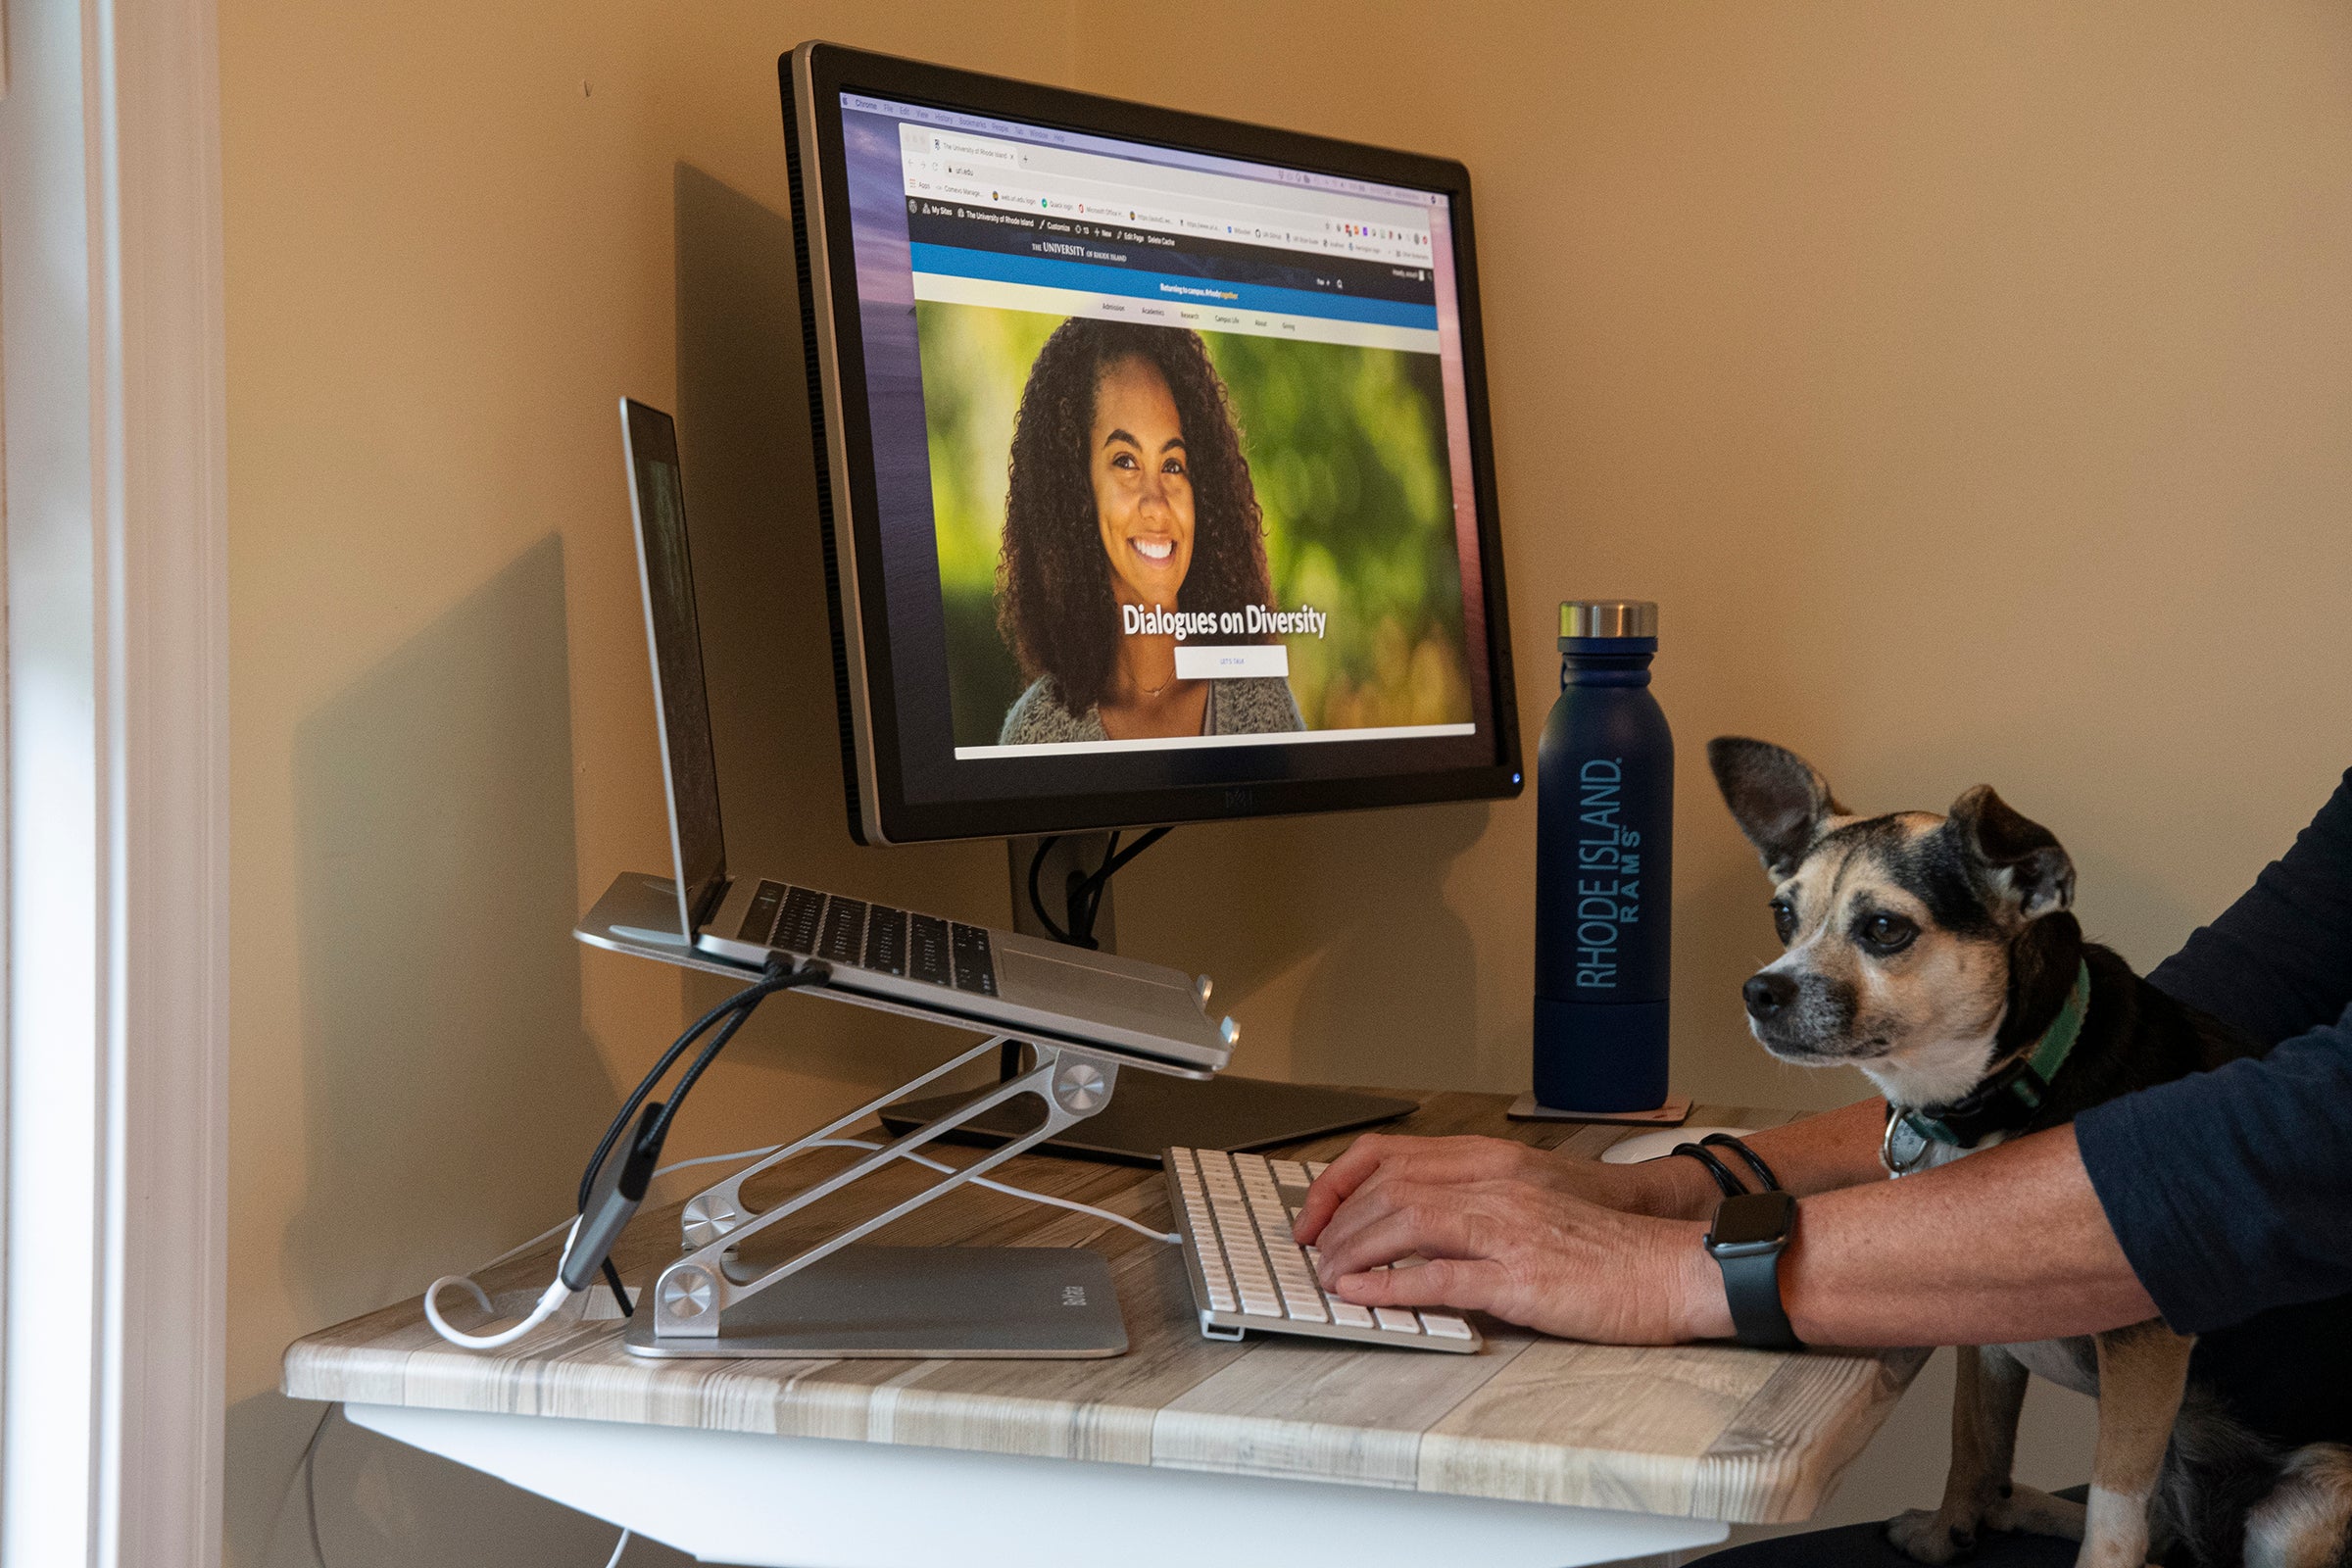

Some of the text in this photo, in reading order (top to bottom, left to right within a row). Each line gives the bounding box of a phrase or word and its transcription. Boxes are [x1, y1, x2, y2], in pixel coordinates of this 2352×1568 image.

[855, 99, 878, 111] Chrome
[884, 103, 894, 114] File
[900, 106, 910, 116] Edit
[935, 113, 954, 124] History
[931, 205, 954, 216] My Sites
[966, 210, 976, 220] The
[976, 212, 1000, 224] University
[1005, 215, 1021, 226] Rhode
[1020, 218, 1035, 227] Island
[1102, 228, 1112, 238] New
[1123, 231, 1145, 244] Edit Page
[1032, 242, 1043, 252] THE
[1043, 242, 1086, 257] UNIVERSITY
[1102, 302, 1125, 312] Admission
[1142, 307, 1165, 317] Academics
[1180, 311, 1200, 320] Research
[1122, 603, 1327, 641] Dialogues on Diversity
[1619, 829, 1641, 923] RAMS
[1576, 879, 1618, 988] RHODE
